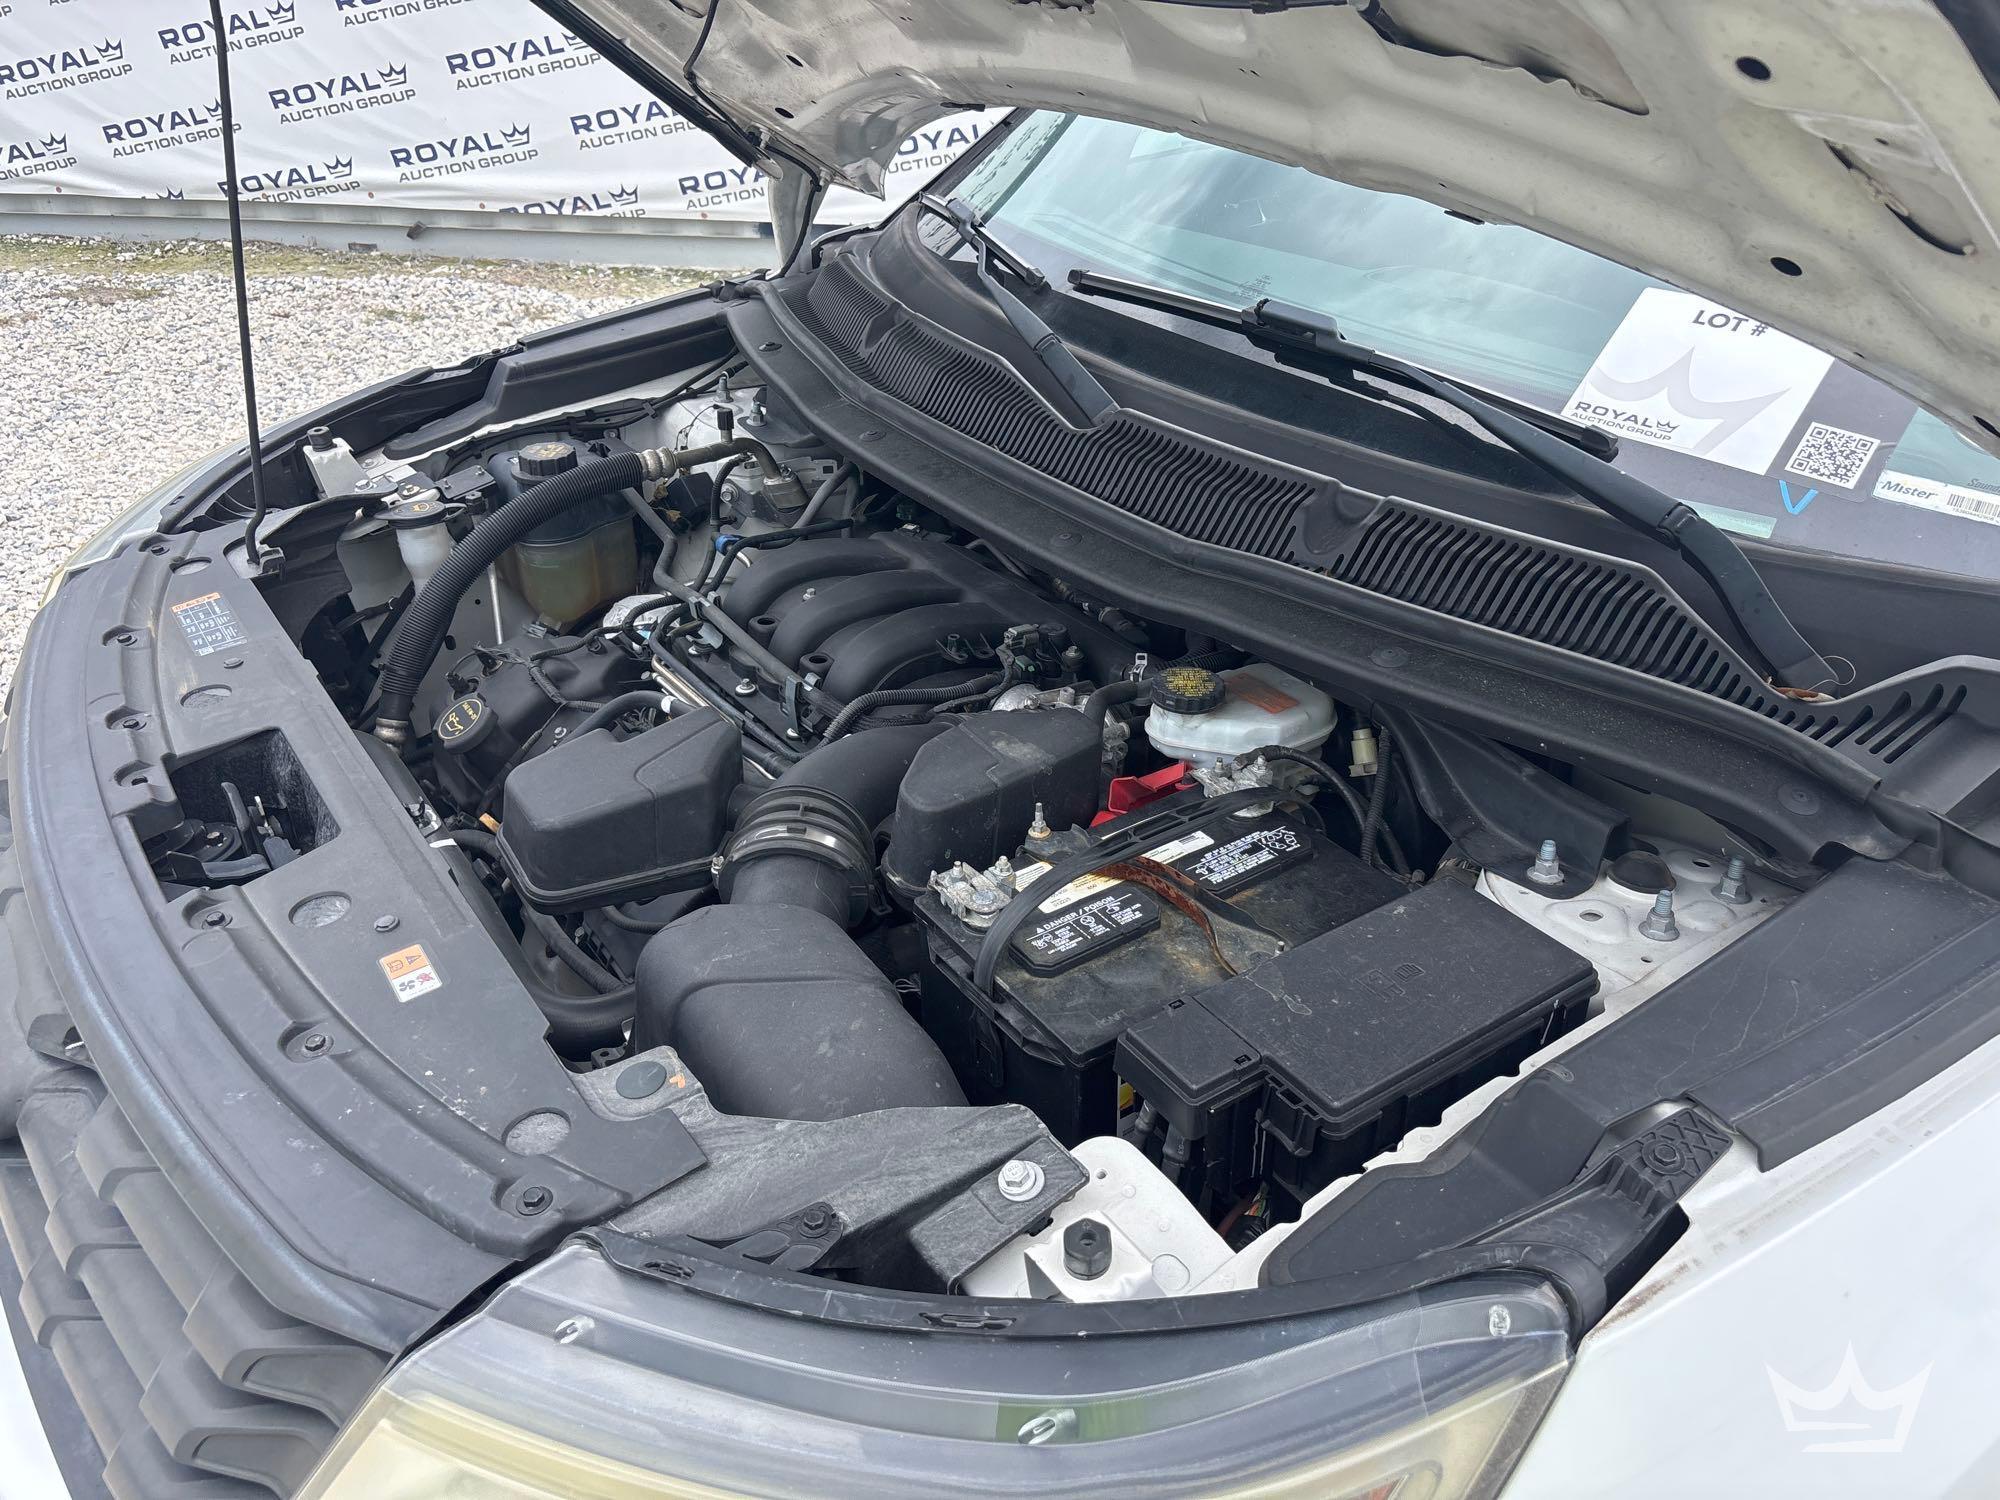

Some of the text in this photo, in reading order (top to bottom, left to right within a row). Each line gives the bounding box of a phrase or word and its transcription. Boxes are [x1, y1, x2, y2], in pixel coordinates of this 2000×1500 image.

[344, 1, 421, 27] AUCTION
[170, 26, 305, 65] AUCTIN GROUP
[446, 36, 565, 75] ROYAL
[6, 64, 133, 100] AUCTION GROUP
[456, 53, 601, 91] AUCTION GROUP
[269, 72, 381, 110] ROYAL
[280, 89, 417, 125] AUCTION GROUP
[102, 107, 209, 143] ROYAL
[569, 100, 680, 135] ROYA
[112, 134, 184, 159] AUCTION
[390, 132, 504, 168] ROYAL
[579, 126, 659, 151] AUCTION
[22, 157, 78, 177] GROUP
[399, 149, 539, 183] AUCTION GROUP
[304, 180, 361, 199] GROUP
[686, 187, 765, 210] AUCTION
[1692, 309, 1749, 332] LOT
[1570, 412, 1672, 441] AUCTION GROUP
[1575, 401, 1653, 429] ROYAL
[1881, 481, 1936, 499] Mister
[1043, 911, 1079, 931] DANGER
[1085, 895, 1116, 914] POISON
